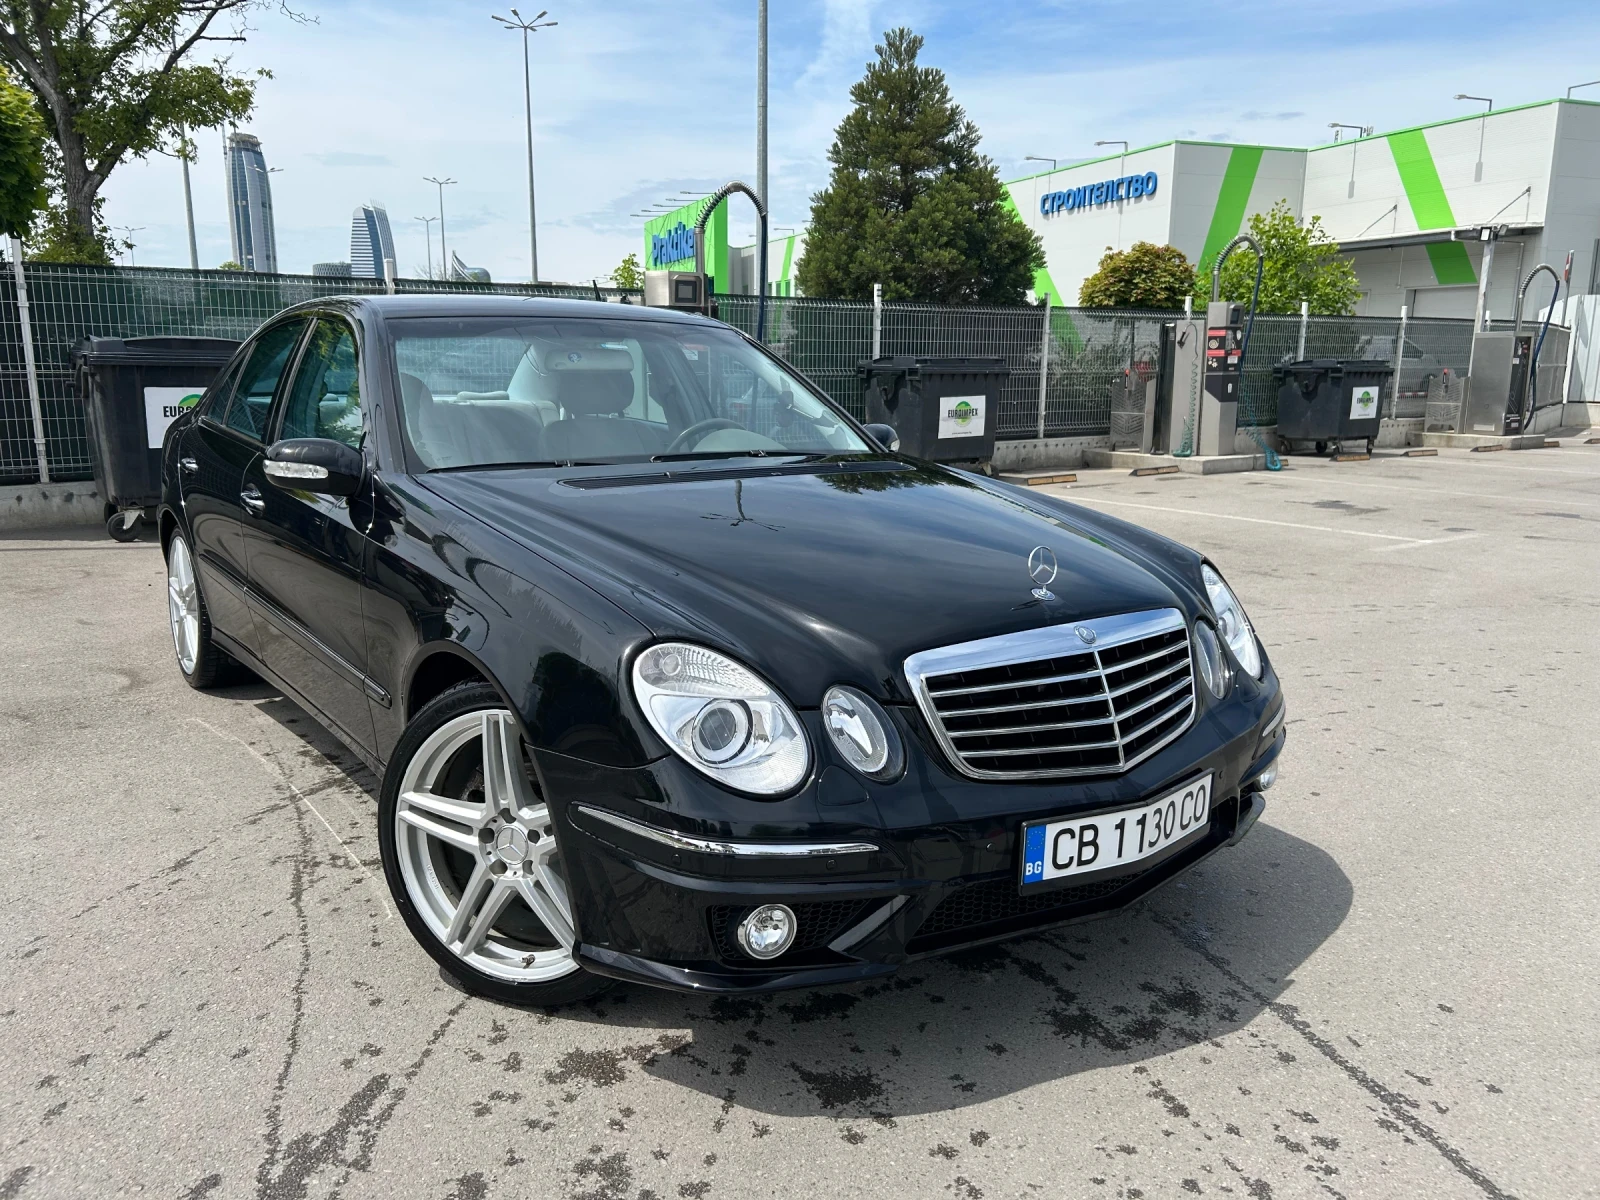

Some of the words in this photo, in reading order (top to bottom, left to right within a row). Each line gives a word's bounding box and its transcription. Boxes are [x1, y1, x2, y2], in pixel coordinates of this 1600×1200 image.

[1040, 171, 1158, 215] СТРОИТЕЛСТВО
[652, 221, 695, 266] Praktike
[1025, 861, 1042, 876] BG
